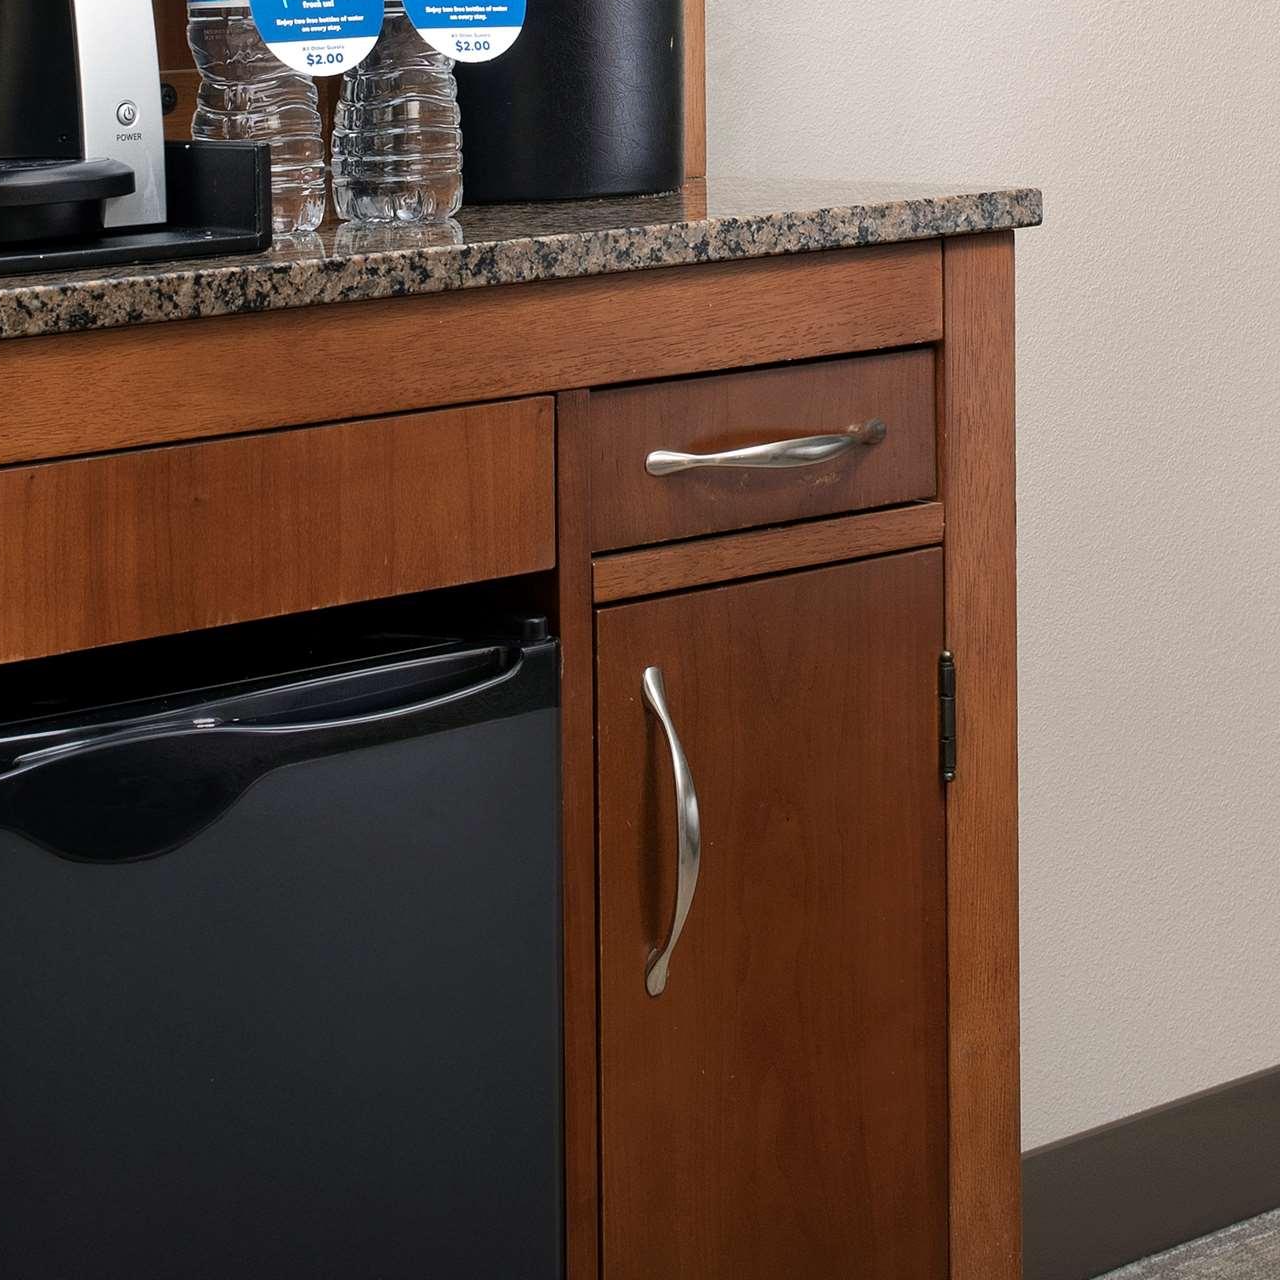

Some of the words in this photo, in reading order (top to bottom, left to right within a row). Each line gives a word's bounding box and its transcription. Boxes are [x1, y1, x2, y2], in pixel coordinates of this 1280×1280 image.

[455, 40, 490, 52] $2.00
[306, 53, 344, 66] $2.00
[116, 132, 142, 142] POWER
